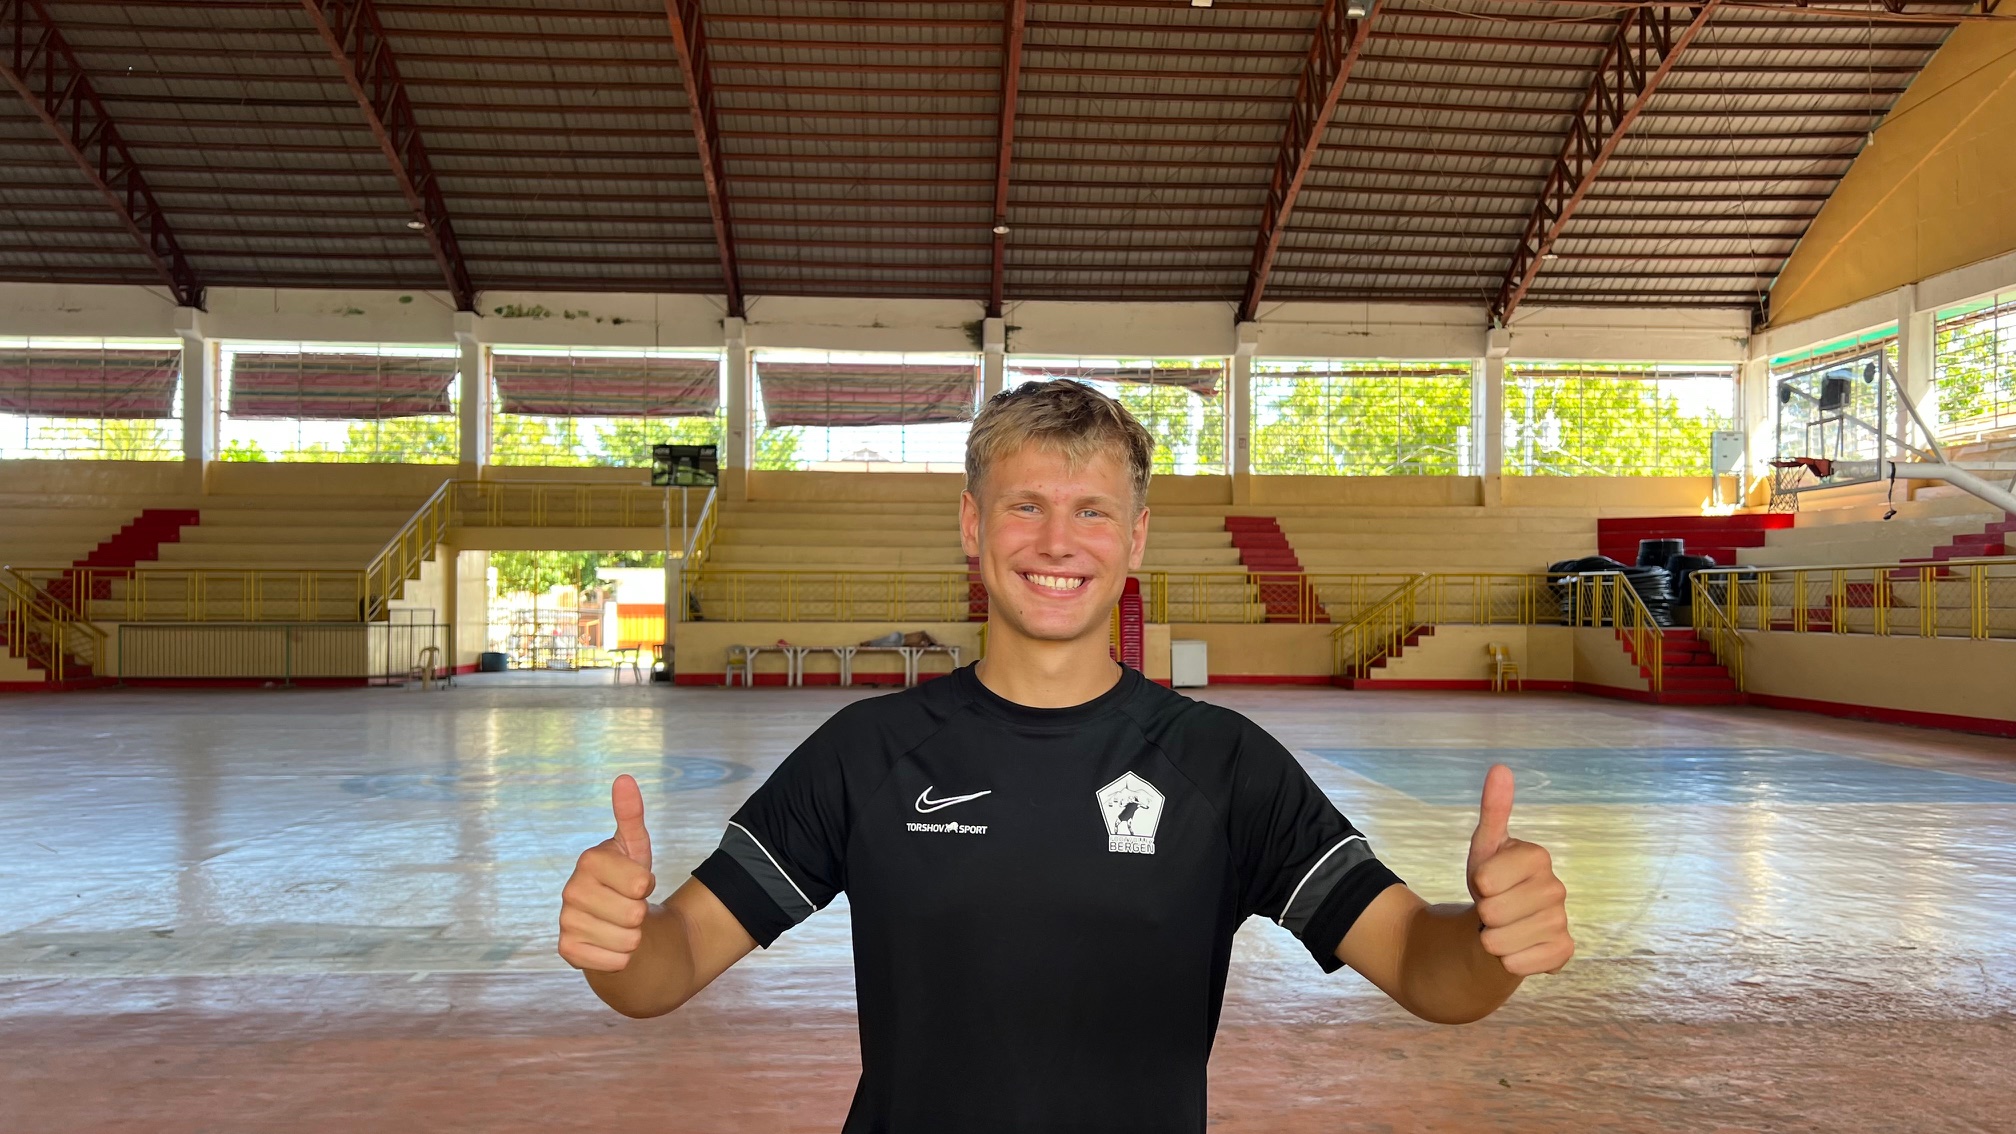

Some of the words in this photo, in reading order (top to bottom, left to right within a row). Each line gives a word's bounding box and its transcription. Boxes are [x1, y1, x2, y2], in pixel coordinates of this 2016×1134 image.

[906, 822, 945, 833] TORSHOV
[959, 824, 988, 835] SPORT
[1109, 841, 1154, 853] BERGEN
